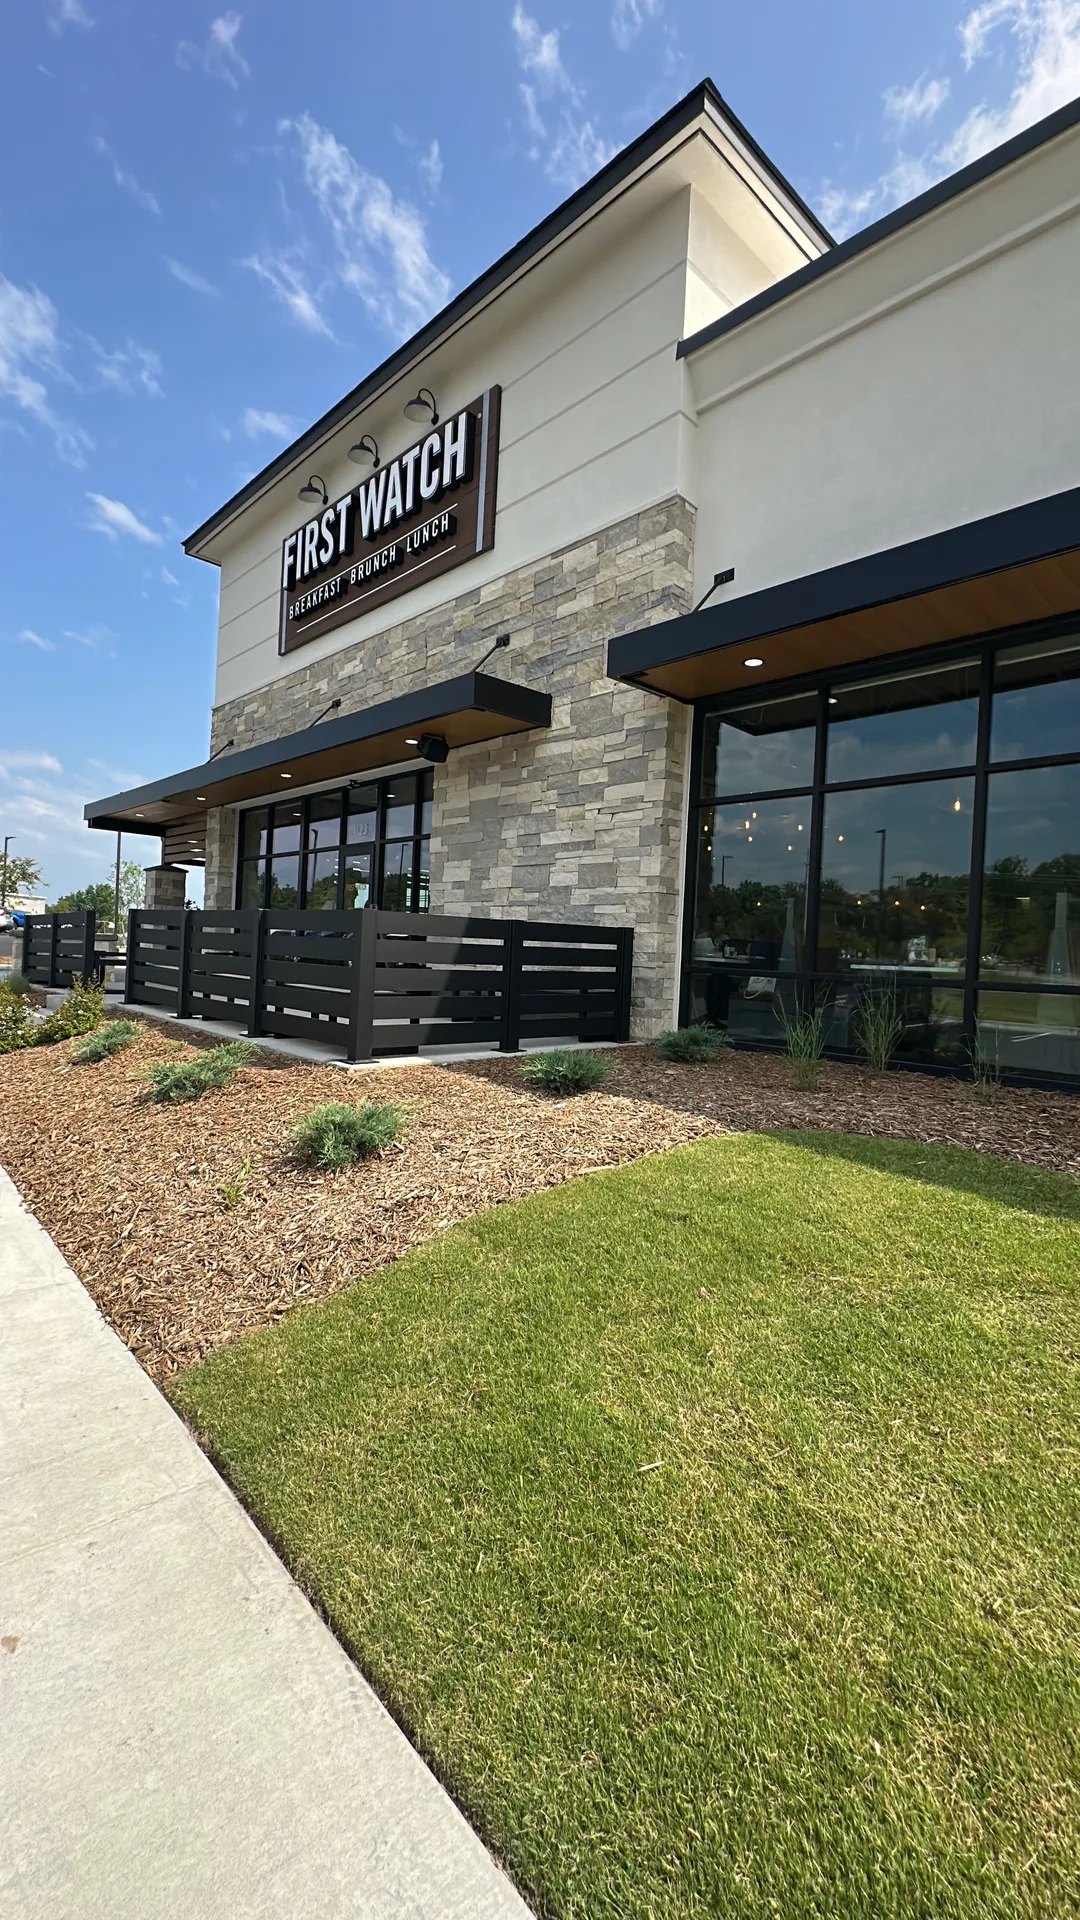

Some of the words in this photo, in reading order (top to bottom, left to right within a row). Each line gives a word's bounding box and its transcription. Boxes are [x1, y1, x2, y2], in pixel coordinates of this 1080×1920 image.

[283, 493, 352, 588] FIRST
[359, 411, 468, 539] WATCH
[289, 577, 341, 620] BREAKFAST
[350, 545, 396, 584] BRUNCH
[406, 513, 449, 552] LUNCH
